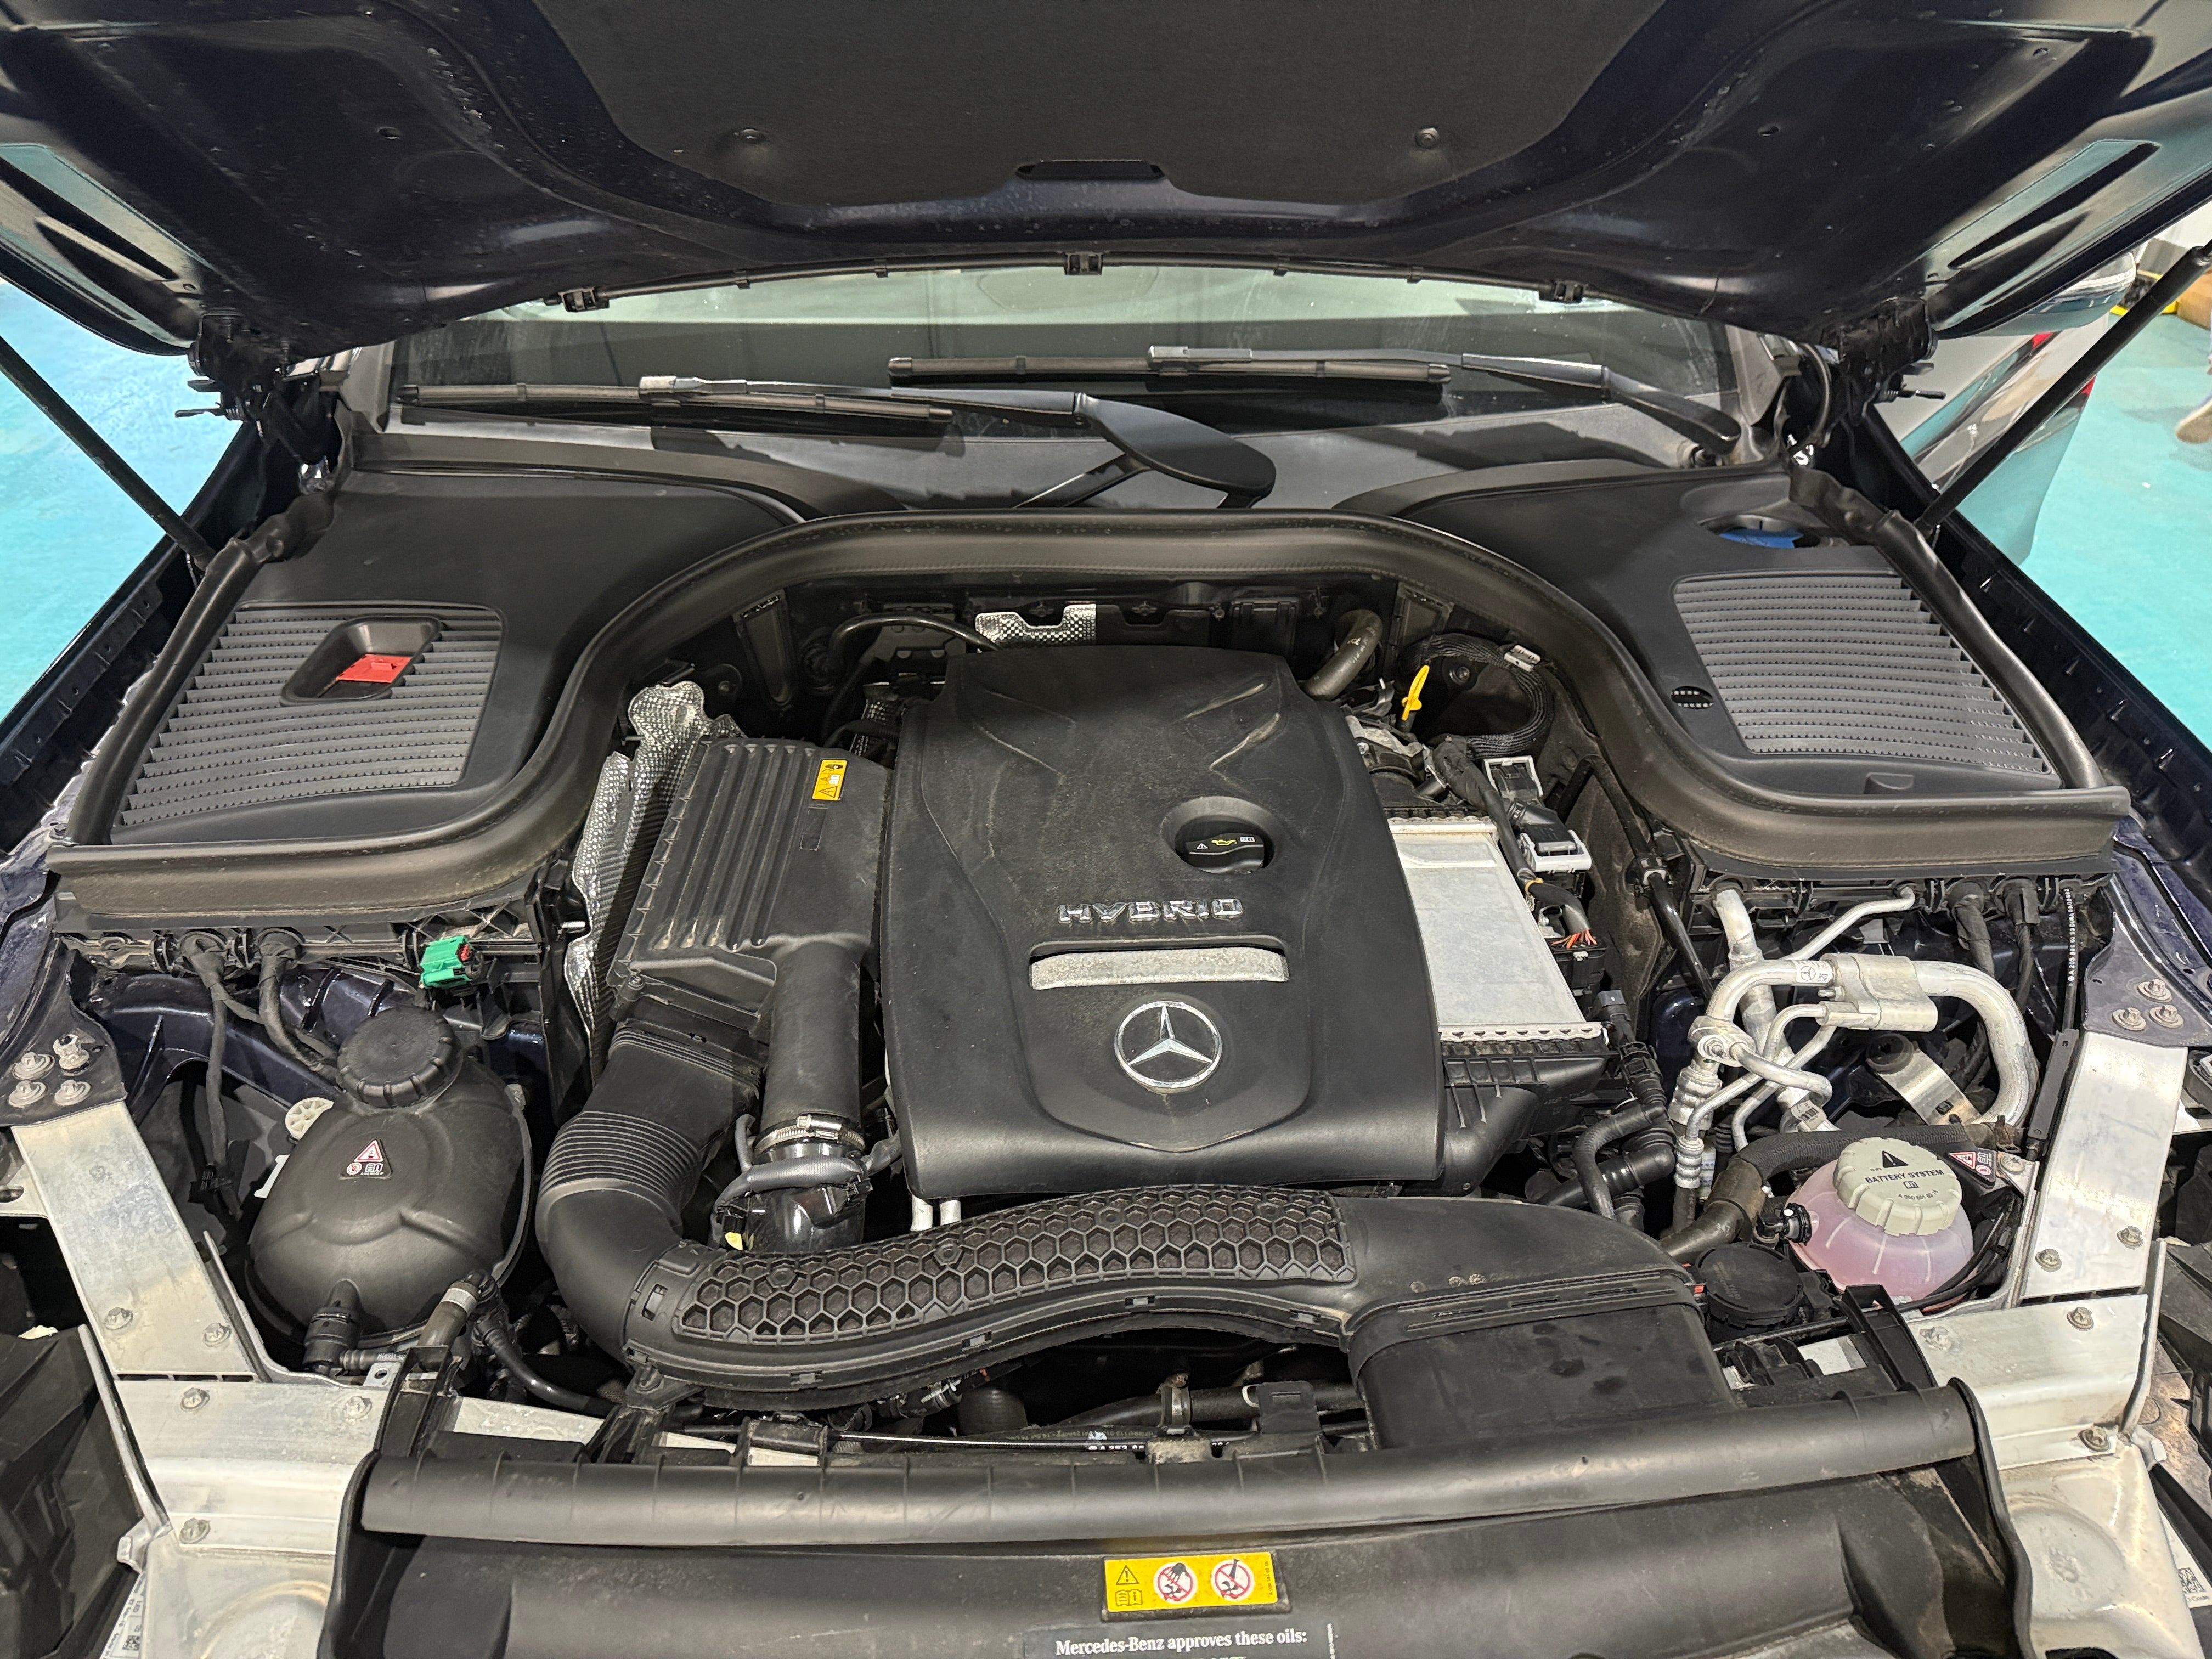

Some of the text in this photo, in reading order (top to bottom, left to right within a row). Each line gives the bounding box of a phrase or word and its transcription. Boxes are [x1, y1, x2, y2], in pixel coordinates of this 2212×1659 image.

[1058, 899, 1243, 923] HYBRID
[1864, 1169, 1945, 1184] BATTERY SYSTEM
[1056, 1628, 1308, 1656] Mercedes-Benz approves these oils:
